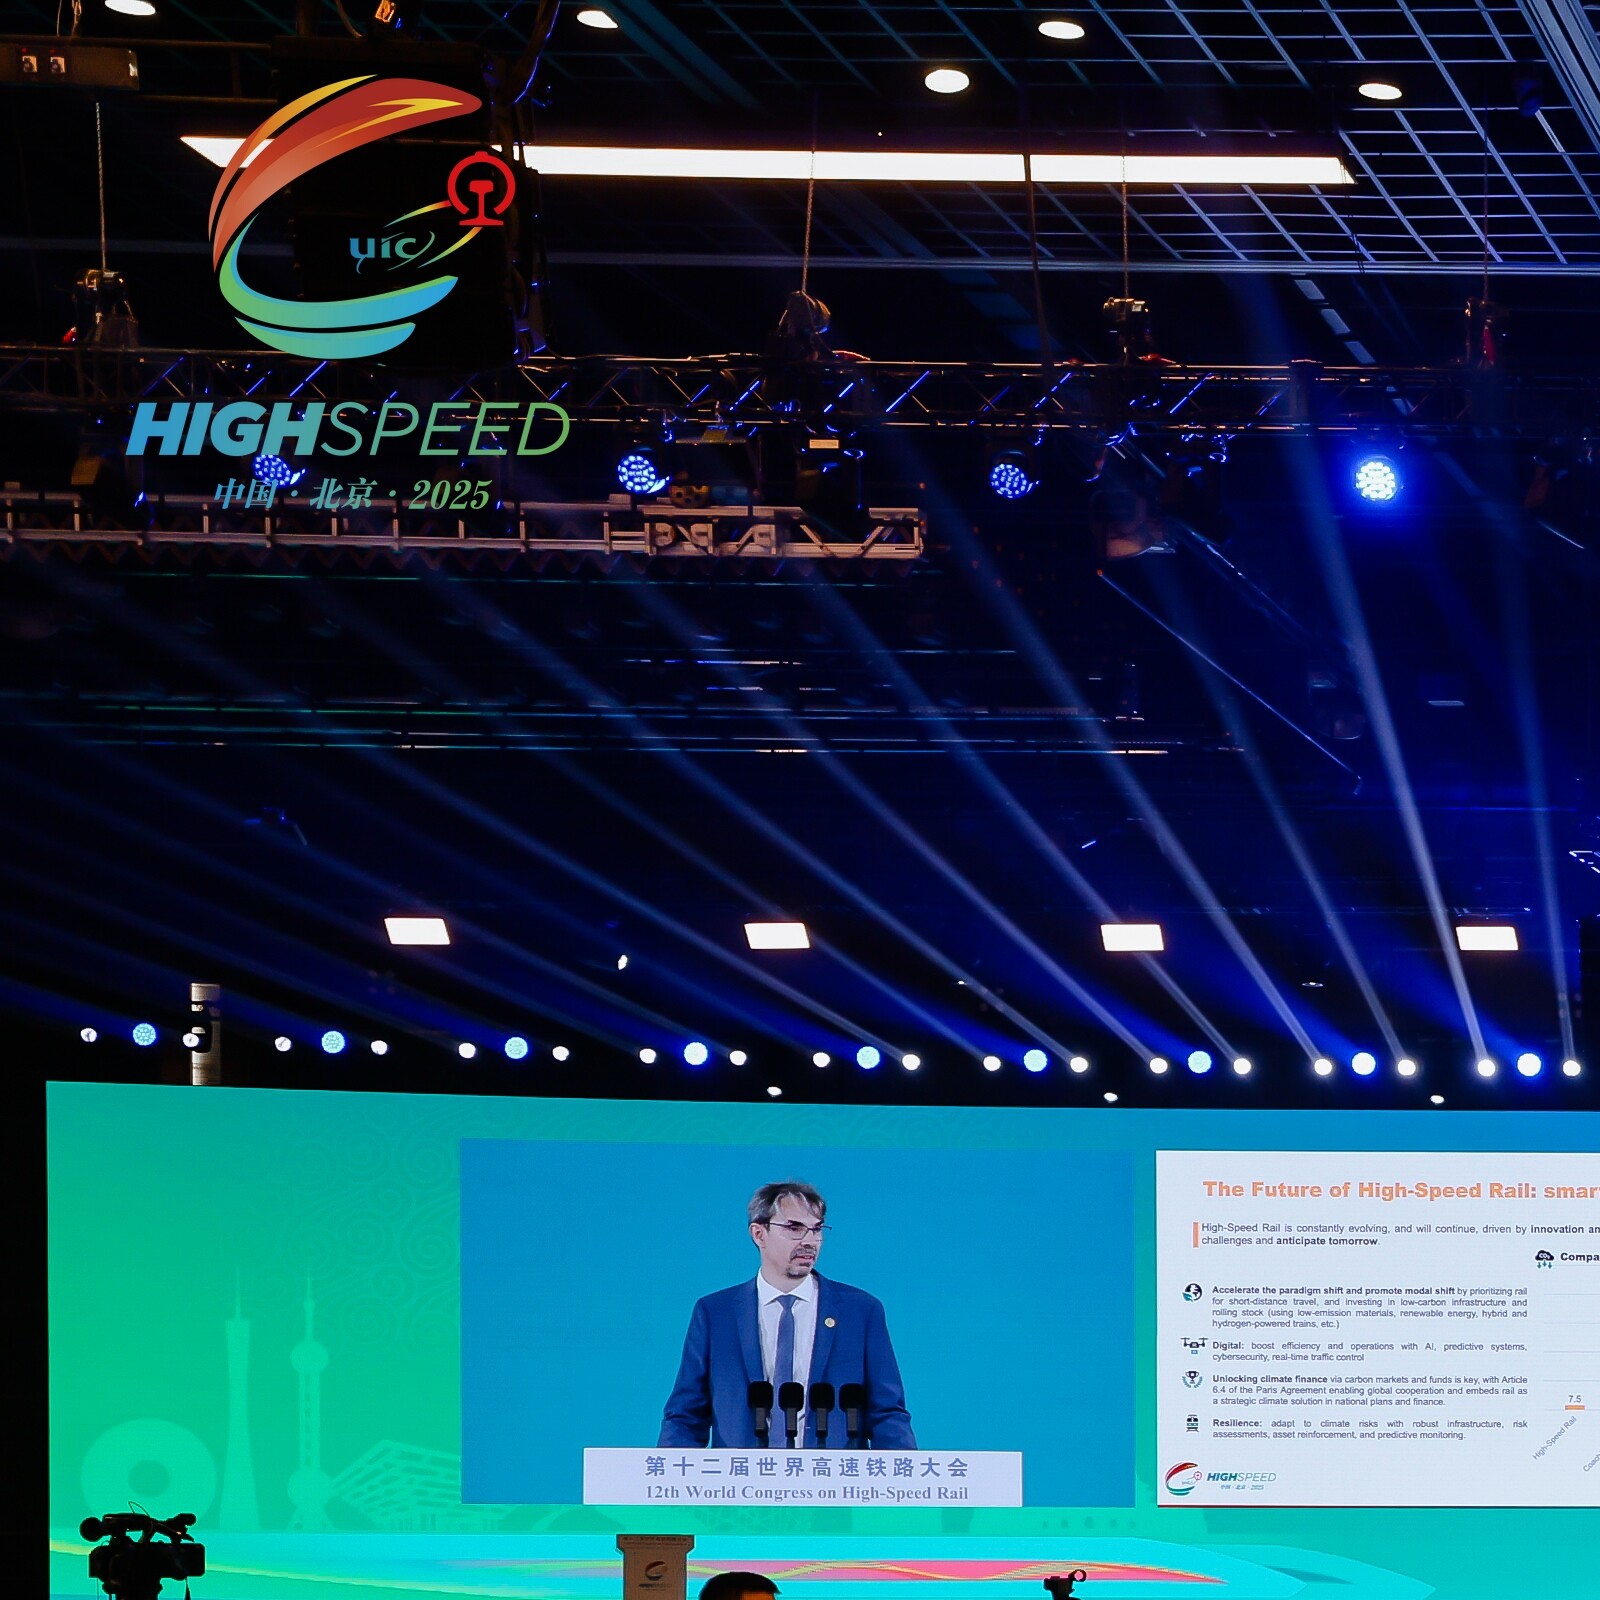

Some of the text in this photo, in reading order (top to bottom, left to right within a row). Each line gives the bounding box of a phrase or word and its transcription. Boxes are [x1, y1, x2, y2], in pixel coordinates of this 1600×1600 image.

[1203, 1181, 1244, 1197] The
[1252, 1181, 1322, 1198] Future
[1329, 1182, 1351, 1197] of
[1358, 1182, 1481, 1202] High-Speed
[1489, 1182, 1536, 1198] Rail:
[1201, 1222, 1258, 1234] High-Speed
[1262, 1223, 1281, 1232] Rail
[1284, 1223, 1293, 1232] is
[1296, 1224, 1345, 1235] constantly
[1348, 1224, 1390, 1235] evolving,
[1394, 1224, 1412, 1233] and
[1416, 1224, 1431, 1233] will
[1435, 1224, 1478, 1234] continue,
[1482, 1224, 1512, 1233] driven
[1515, 1224, 1527, 1236] by
[1530, 1224, 1584, 1234] innovation
[1201, 1236, 1253, 1247] challenges
[1255, 1236, 1273, 1245] and
[1276, 1236, 1326, 1247] anticipate
[1212, 1286, 1260, 1294] Accelerate
[1262, 1286, 1277, 1294] the
[1279, 1286, 1321, 1296] paradigm
[1323, 1286, 1344, 1294] shift
[1346, 1286, 1363, 1295] and
[1365, 1287, 1403, 1296] promote
[1405, 1287, 1433, 1295] modal
[1435, 1287, 1455, 1295] shift
[1469, 1287, 1513, 1297] prioritizing
[1514, 1287, 1527, 1295] rail
[1568, 1394, 1582, 1403] 7.5
[645, 1455, 968, 1478] 第十二届世界高速铁路大会
[1206, 1472, 1277, 1482] HIGHSPEED
[646, 1485, 968, 1503] 12th World Congress on High-Speed Rail
